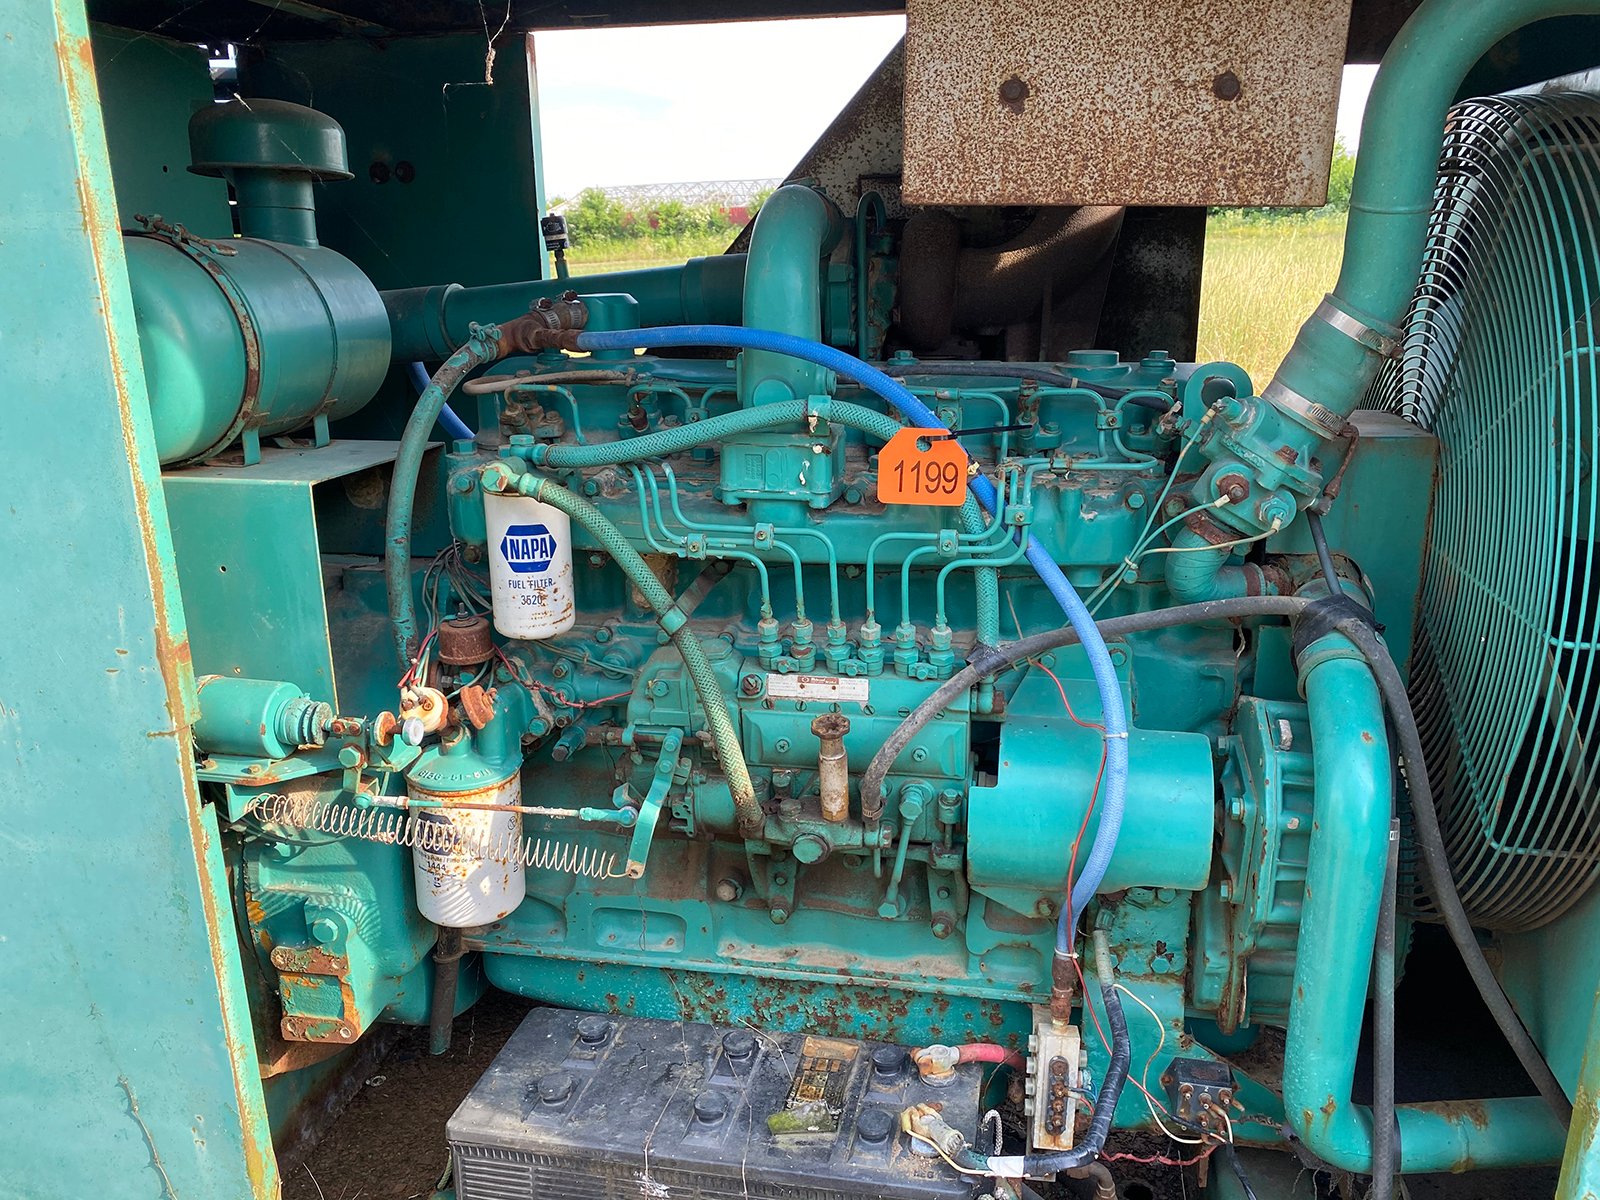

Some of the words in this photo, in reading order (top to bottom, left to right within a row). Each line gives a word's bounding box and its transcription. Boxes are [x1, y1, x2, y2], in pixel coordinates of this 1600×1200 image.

[894, 459, 959, 495] 1199
[509, 537, 549, 560] NAPA
[508, 579, 526, 590] FUEL
[529, 577, 553, 589] FILTER
[427, 861, 446, 871] 1444
